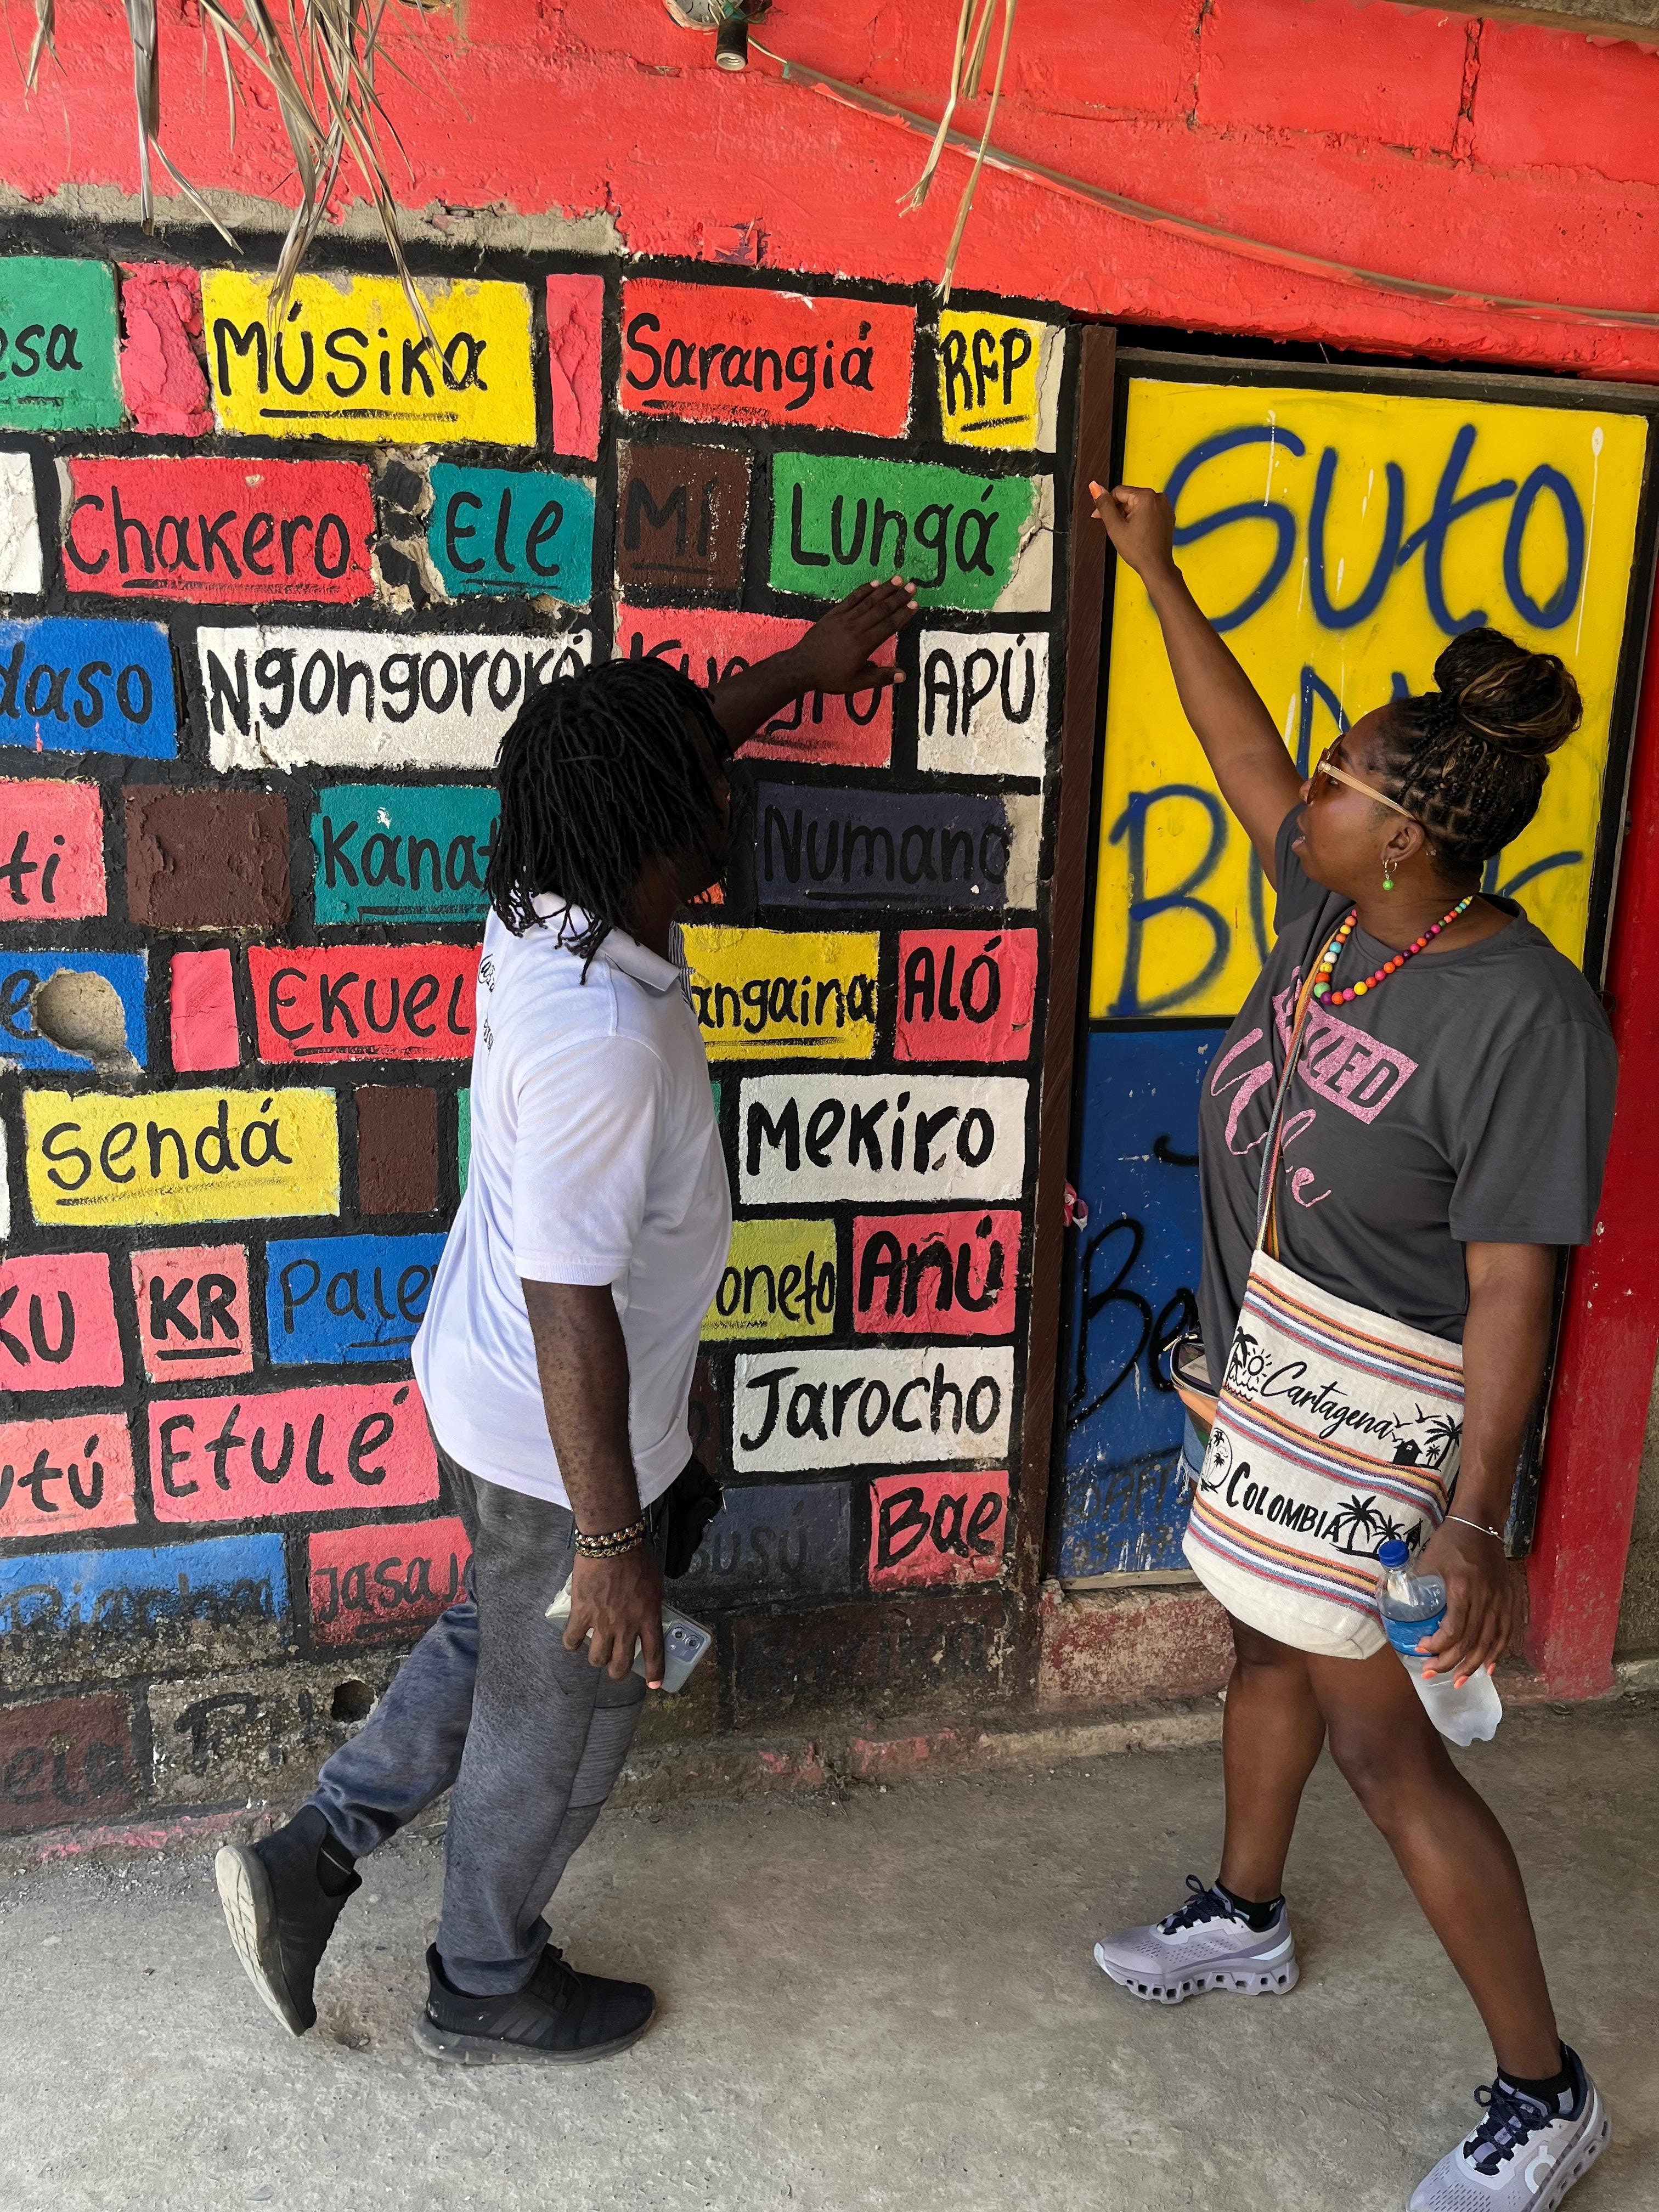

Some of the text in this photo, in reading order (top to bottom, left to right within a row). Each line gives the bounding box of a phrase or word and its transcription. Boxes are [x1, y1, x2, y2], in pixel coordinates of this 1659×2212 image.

[0, 324, 83, 381] sa
[626, 312, 874, 411] Sarangiá
[64, 485, 351, 579] Chakero
[445, 488, 564, 576] Ele
[791, 482, 1000, 589] Lungá
[924, 634, 1035, 736] APÚ
[904, 935, 1003, 1023] Aló
[746, 1091, 995, 1176] Mekiro
[149, 1273, 240, 1341] KR
[279, 1258, 439, 1334] Pale
[159, 1386, 410, 1498] Etulé
[741, 1363, 1001, 1452] Jarocho
[1260, 1362, 1396, 1440] Cartagena
[877, 1486, 1002, 1570] Bae
[1226, 1462, 1345, 1543] COLOMBIA
